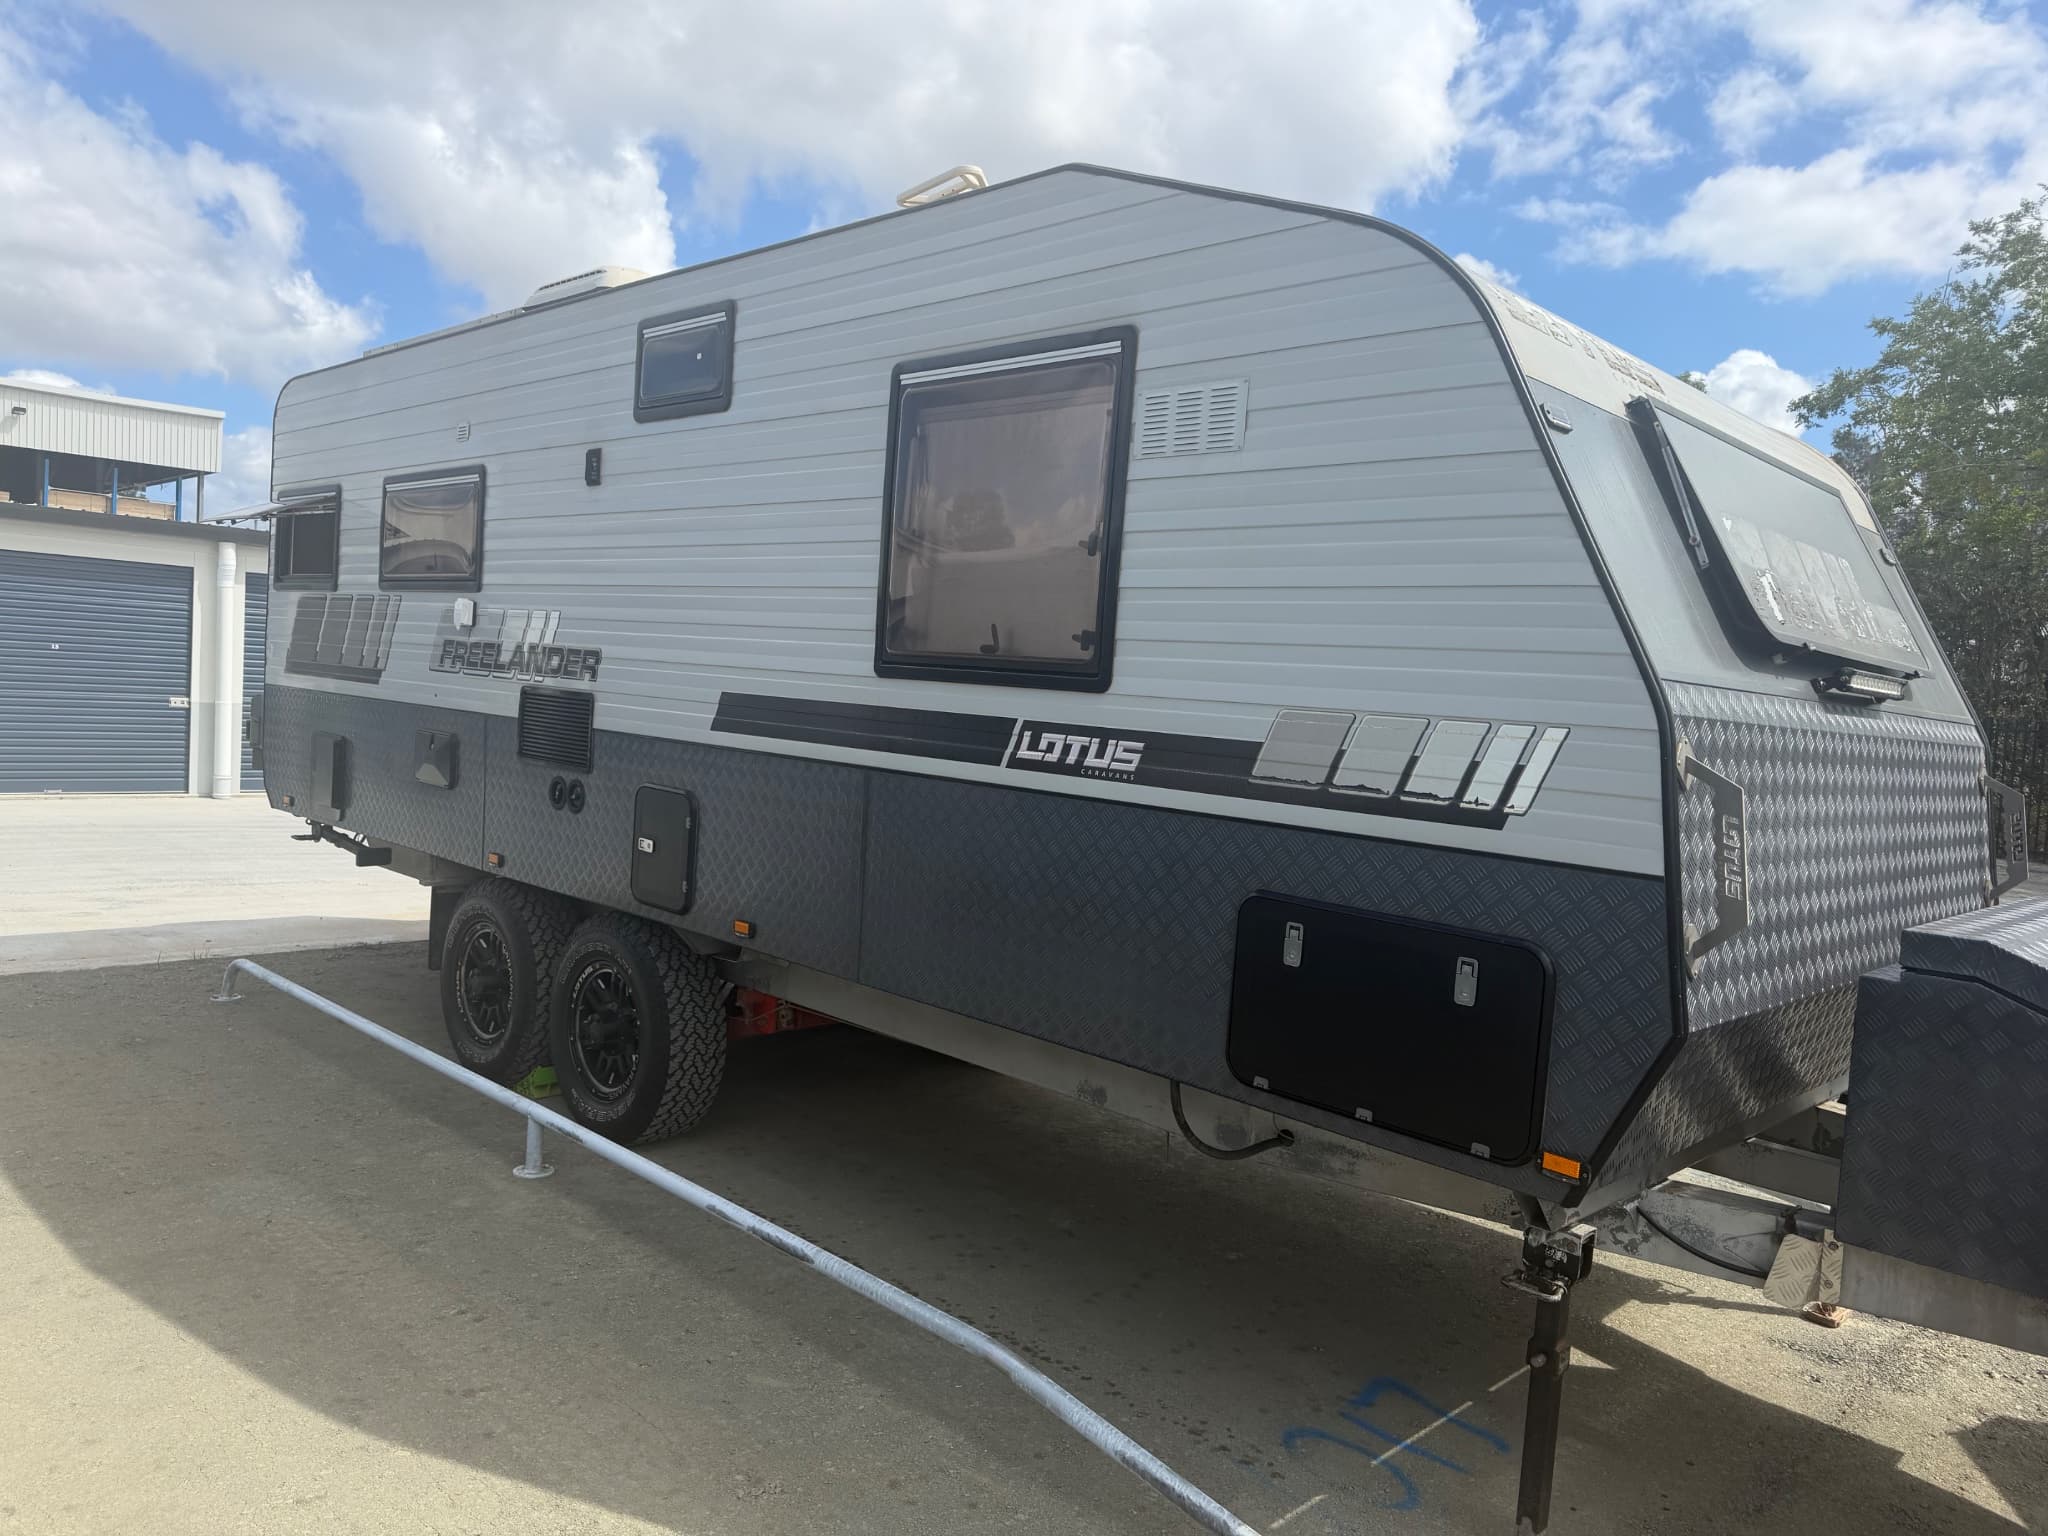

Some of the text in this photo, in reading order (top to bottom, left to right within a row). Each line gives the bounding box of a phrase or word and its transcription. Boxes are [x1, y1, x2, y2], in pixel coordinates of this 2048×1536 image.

[437, 638, 602, 682] FREELANDER
[1016, 730, 1146, 771] LOTUS
[1080, 768, 1136, 780] CARAVANS
[1722, 814, 1742, 901] LOTUS
